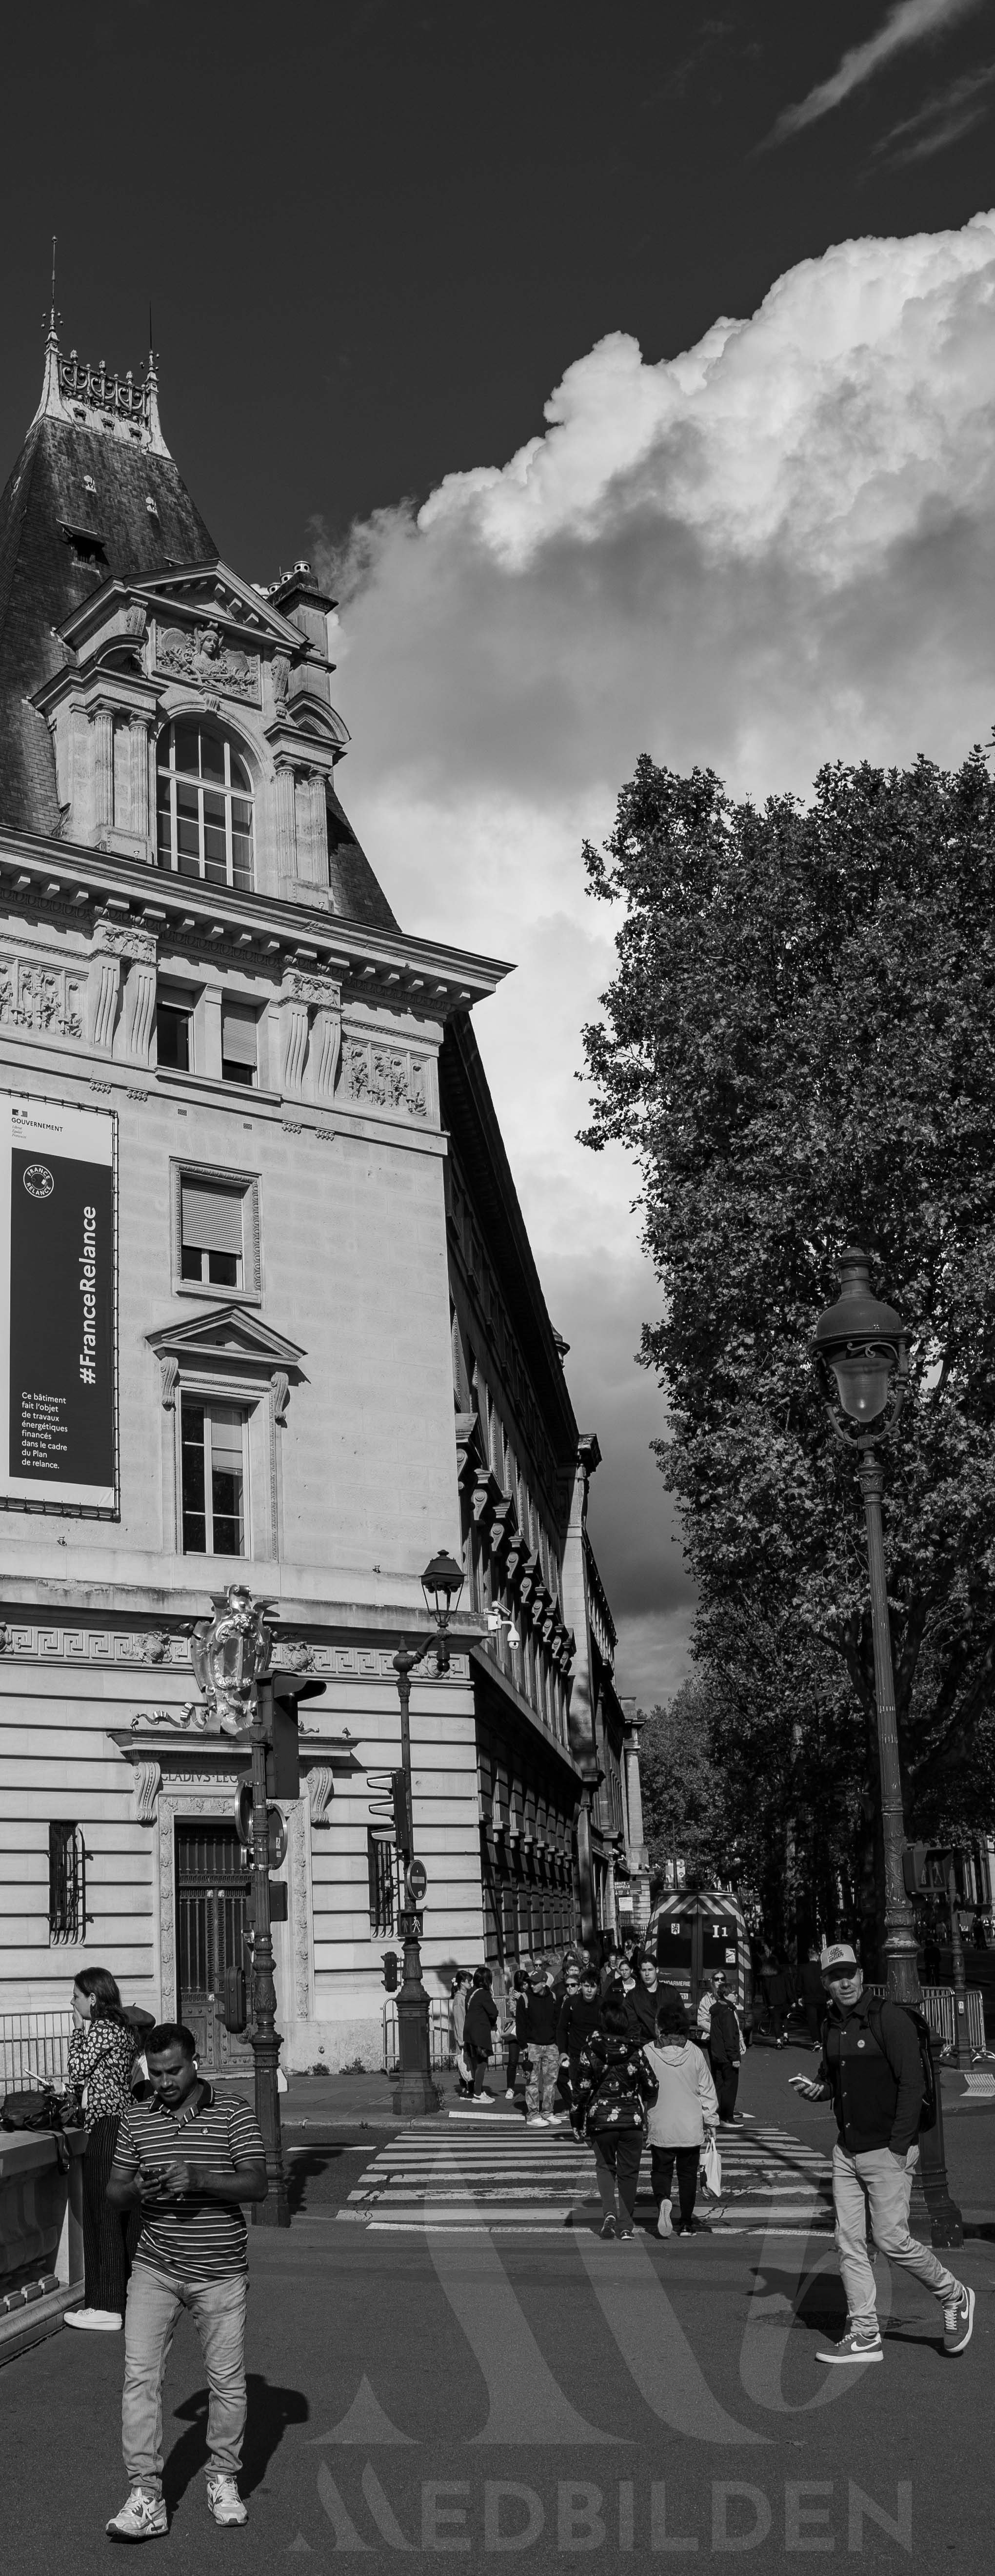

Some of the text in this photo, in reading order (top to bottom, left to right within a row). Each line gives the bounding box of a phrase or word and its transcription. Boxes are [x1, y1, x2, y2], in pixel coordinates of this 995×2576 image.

[12, 1118, 63, 1132] GOUVERNEMENT
[27, 1167, 50, 1180] FRANCE
[26, 1182, 51, 1195] RELANCE
[79, 1206, 96, 1384] #FranceRelance
[34, 1393, 66, 1404] bâtiment
[33, 1413, 60, 1421] travaux
[22, 1420, 68, 1433] énergétiques
[22, 1430, 52, 1439] financés
[33, 1450, 47, 1458] Plan
[33, 1460, 60, 1469] relance.
